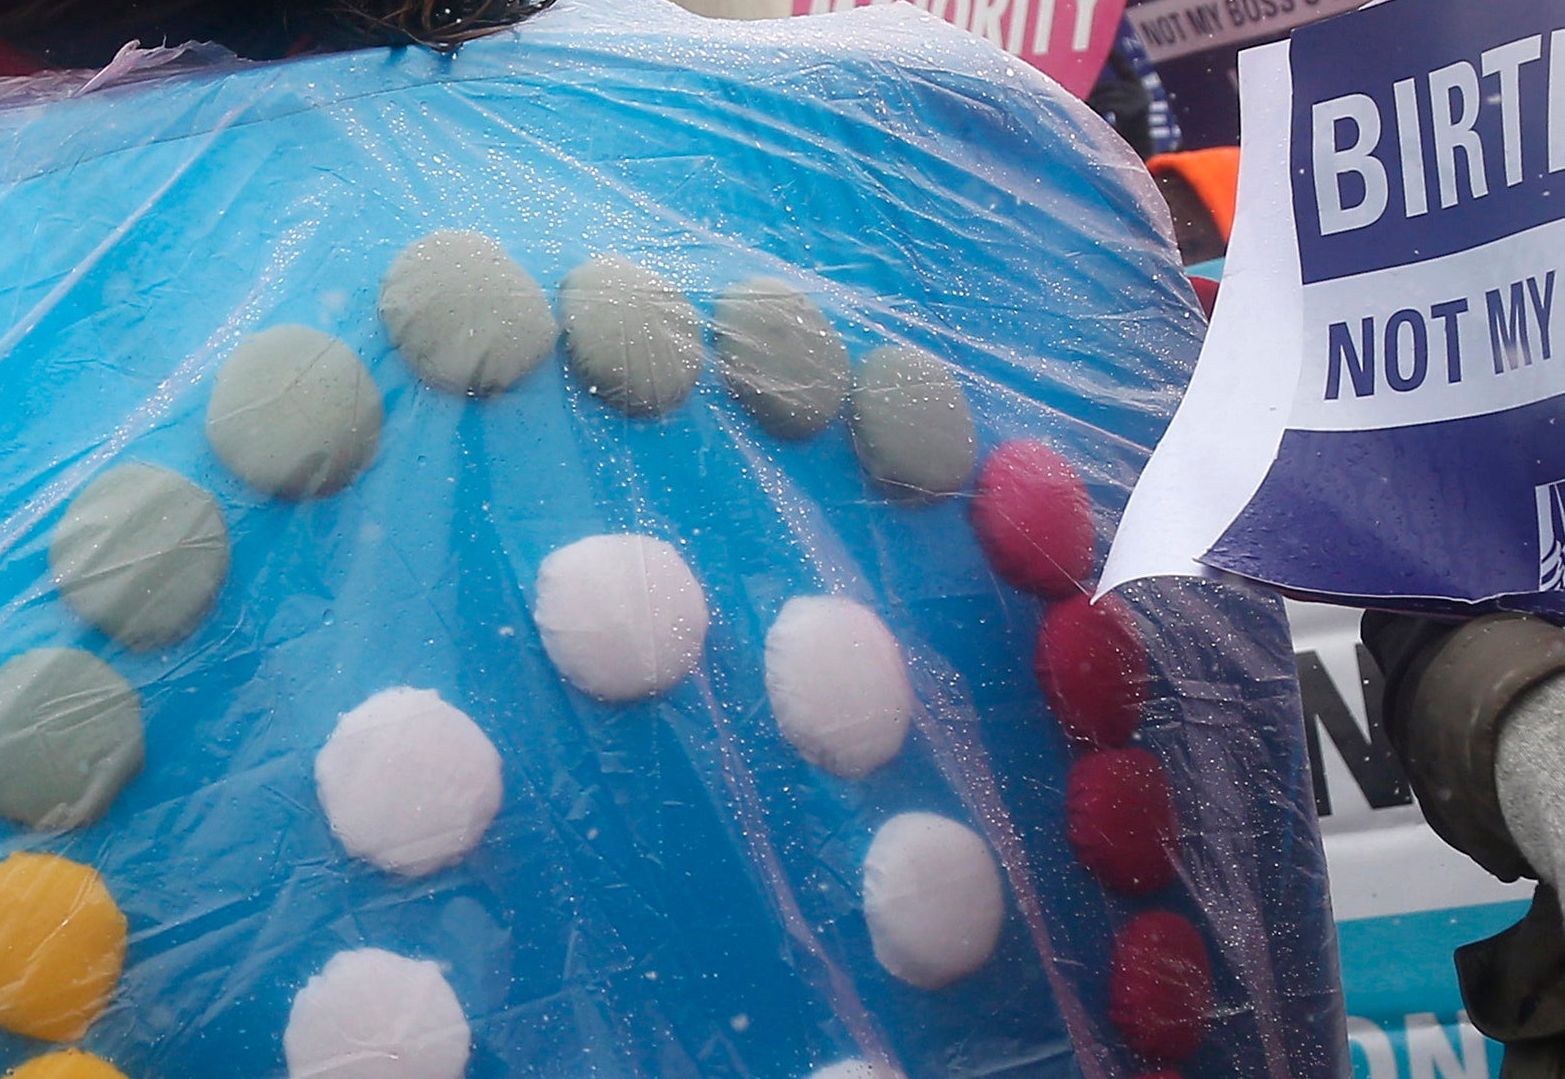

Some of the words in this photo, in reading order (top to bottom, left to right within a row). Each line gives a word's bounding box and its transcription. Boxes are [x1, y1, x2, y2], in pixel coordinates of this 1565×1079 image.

[1141, 11, 1185, 47] NOT
[1186, 2, 1224, 36] MY
[1312, 29, 1565, 237] BIRT
[1324, 298, 1468, 401] NOT
[1485, 270, 1556, 375] MY
